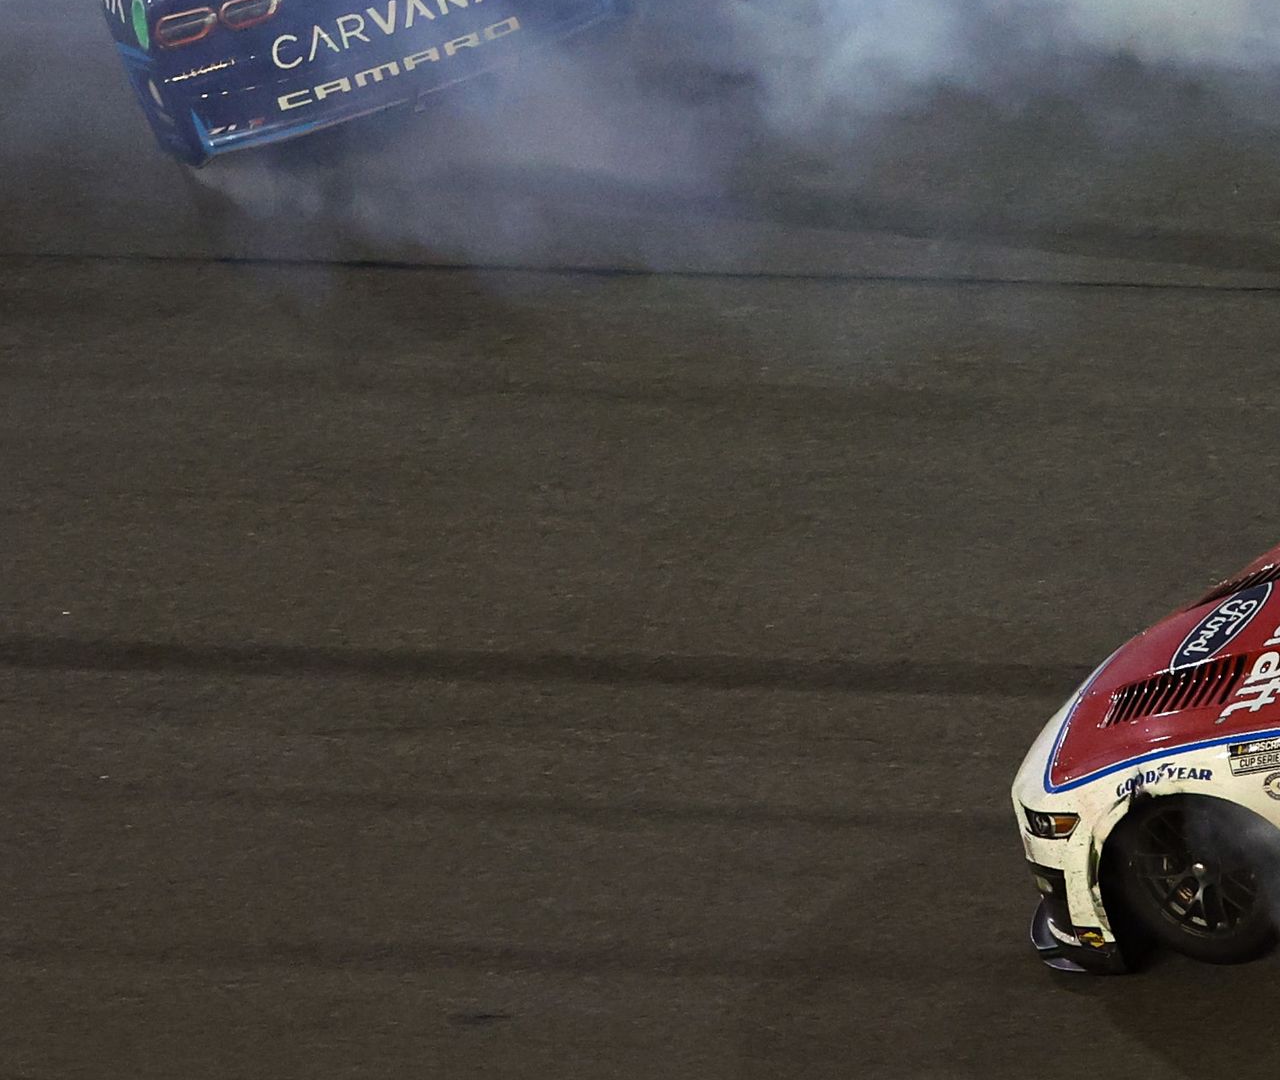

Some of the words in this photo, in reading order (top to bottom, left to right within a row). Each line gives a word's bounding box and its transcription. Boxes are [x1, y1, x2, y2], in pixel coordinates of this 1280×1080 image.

[277, 17, 520, 111] CAMARO
[1183, 597, 1259, 658] Ford
[1116, 762, 1213, 798] GOODYEAR
[1239, 756, 1256, 768] CUP
